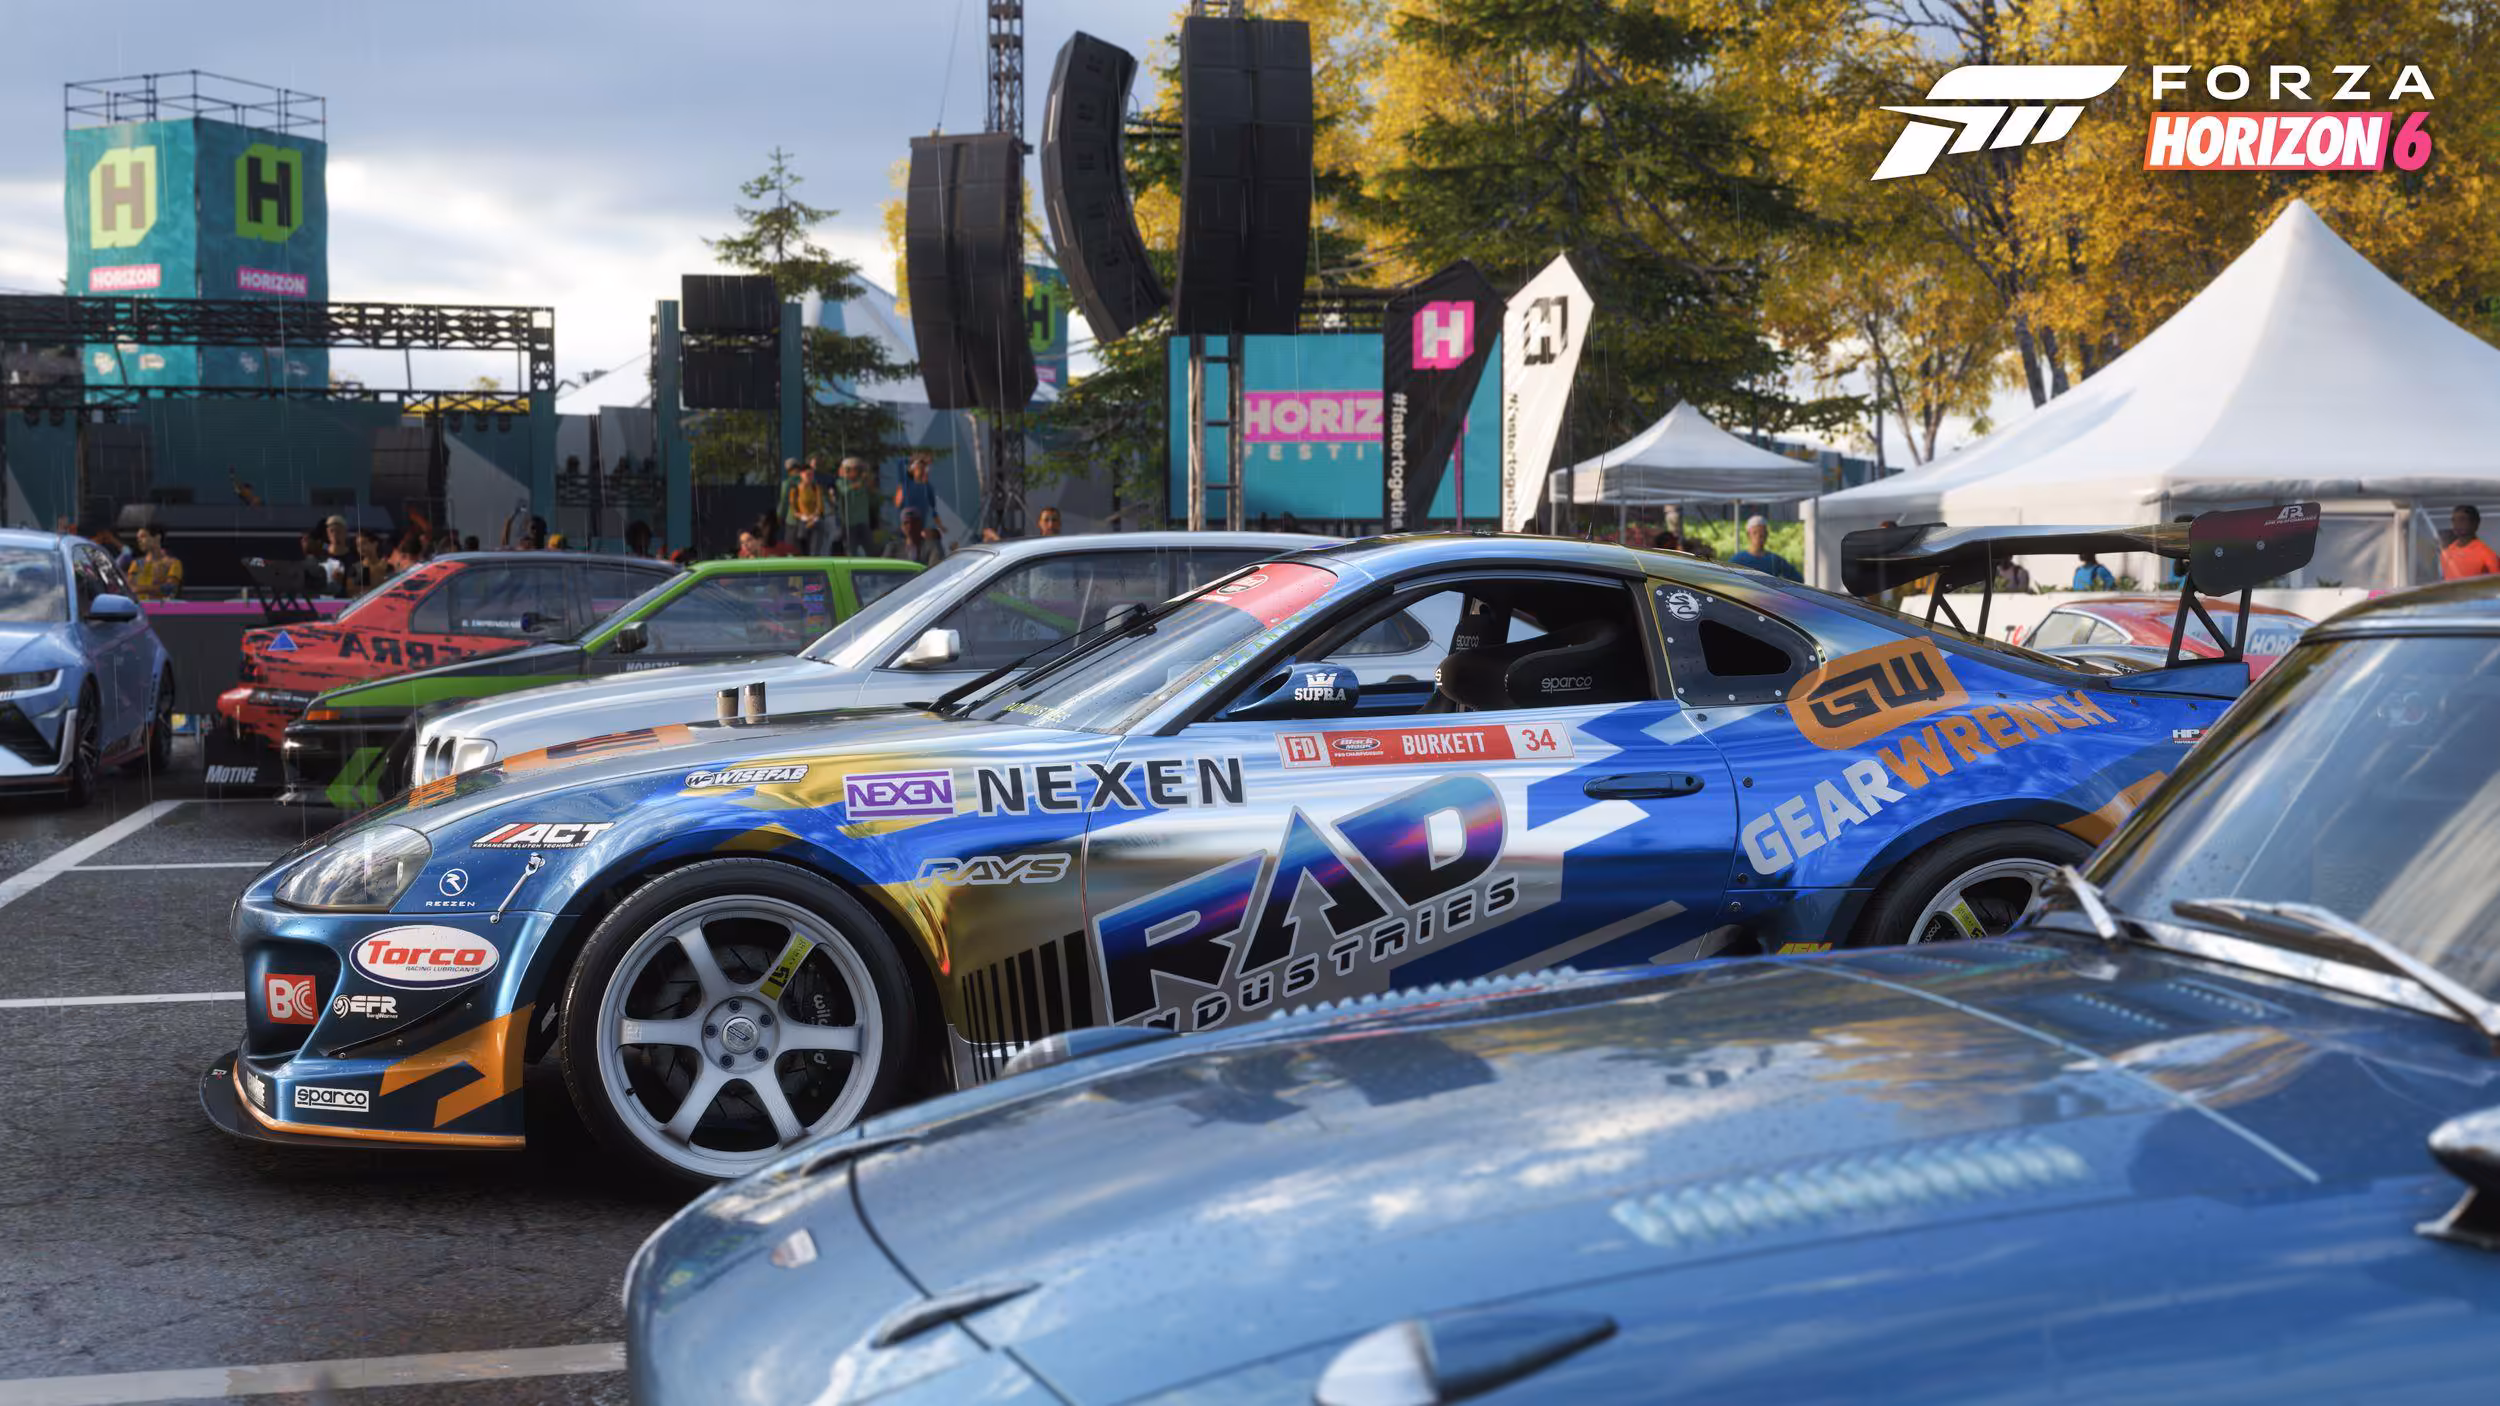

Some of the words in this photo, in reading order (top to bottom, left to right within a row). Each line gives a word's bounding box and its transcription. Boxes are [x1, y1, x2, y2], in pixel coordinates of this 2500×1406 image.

[102, 161, 145, 231] H
[247, 155, 291, 227] H
[92, 268, 159, 287] HORIZON
[239, 269, 306, 294] HORIZON
[1422, 309, 1465, 358] H
[1244, 444, 1383, 461] FESTI
[1387, 392, 1408, 528] #fastertogethe
[1294, 686, 1347, 702] SUPRA
[1541, 675, 1593, 694] sparco
[1289, 737, 1317, 760] FD
[1401, 731, 1485, 756] BURKETT
[1521, 728, 1557, 752] 34
[205, 764, 259, 784] MOTIVE
[714, 766, 808, 785] WISEFAB
[846, 782, 954, 808] NEXEN
[977, 756, 1247, 815] NEXEN
[503, 822, 615, 843] ACT
[914, 853, 1072, 889] RAYS
[425, 900, 476, 908] REEZEN
[1092, 772, 1509, 1027] RAD
[367, 940, 487, 966] Torco
[1143, 872, 1520, 1033] NDUSTRIES
[268, 979, 314, 1020] BC
[350, 995, 398, 1014] EFR
[813, 993, 832, 1065] wild
[296, 1087, 368, 1108] sparco
